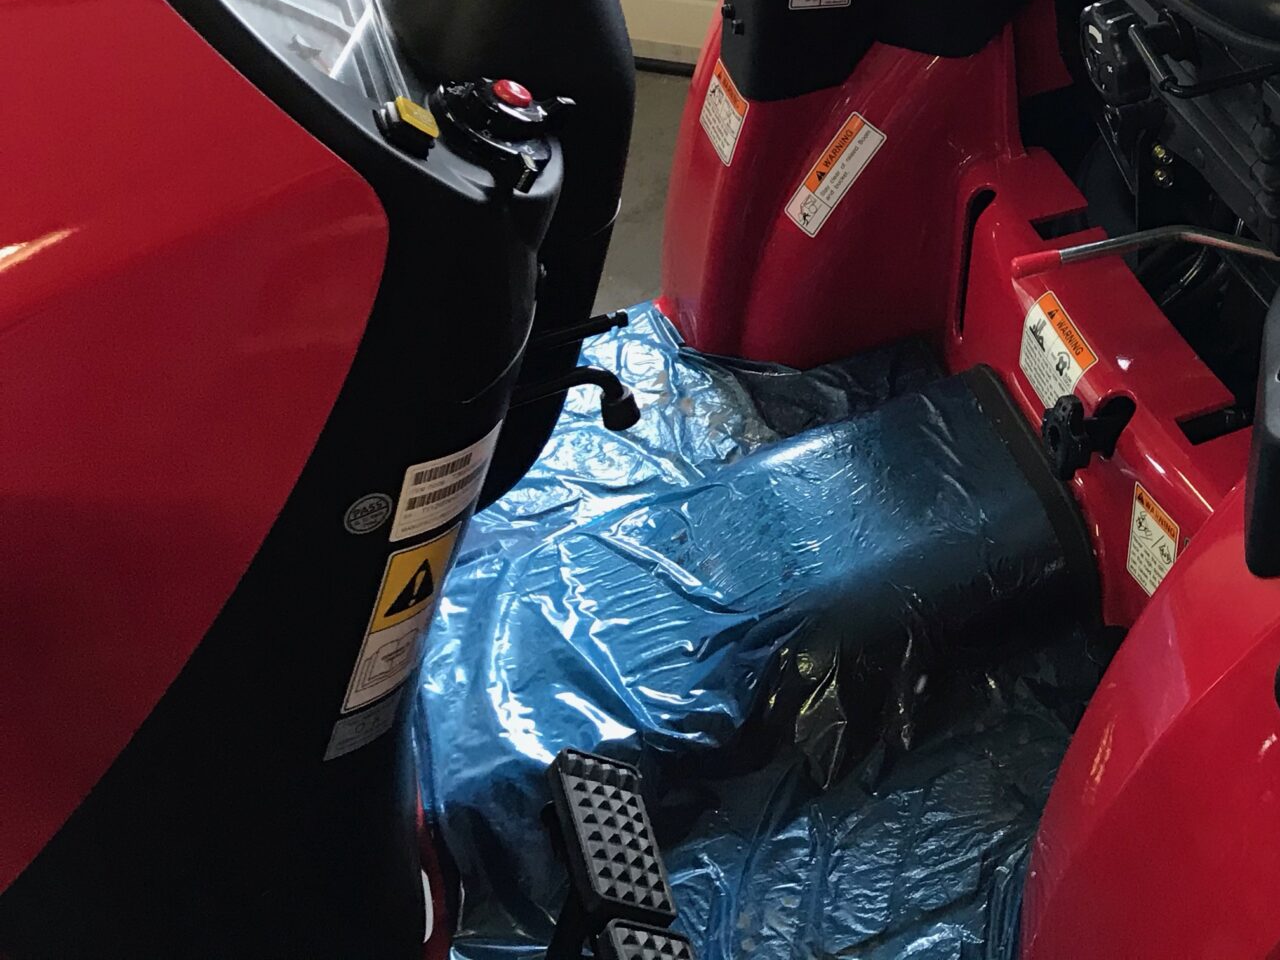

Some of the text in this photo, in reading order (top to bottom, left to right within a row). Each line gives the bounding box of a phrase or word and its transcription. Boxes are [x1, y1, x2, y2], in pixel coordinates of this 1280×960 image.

[822, 128, 854, 168] WARNING
[1056, 320, 1084, 357] WARNING
[1144, 501, 1176, 539] WARNING
